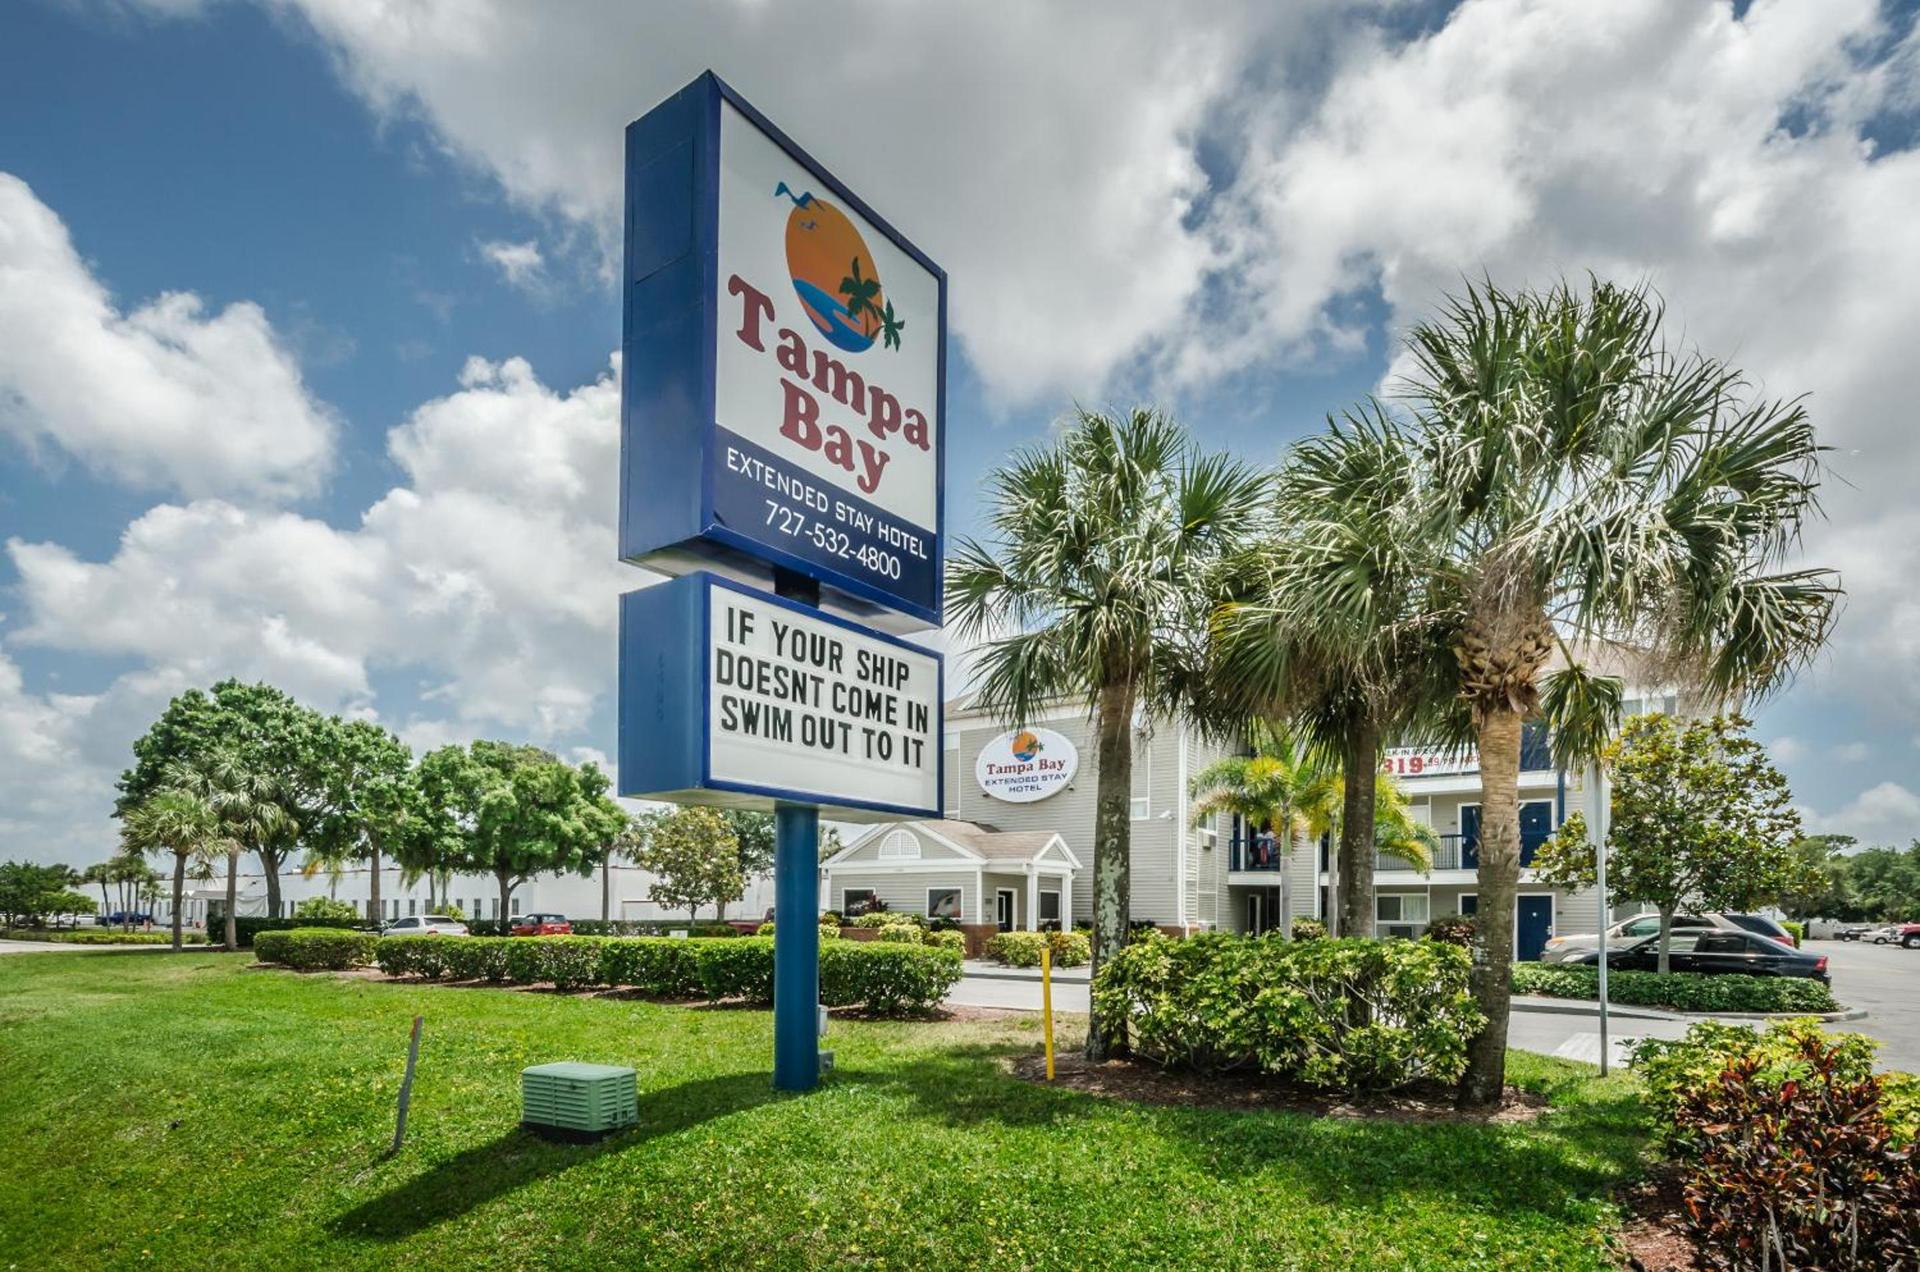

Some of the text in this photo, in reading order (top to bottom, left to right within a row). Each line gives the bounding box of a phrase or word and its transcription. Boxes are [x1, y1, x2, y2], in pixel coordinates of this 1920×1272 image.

[728, 274, 930, 452] Tampa
[780, 377, 890, 494] Bay
[727, 447, 928, 560] EXTENDED STAY HOTEL
[765, 499, 901, 580] 727-532-4800
[727, 606, 909, 691] IF YOUR SHIP
[716, 648, 824, 709] DOESNT
[832, 681, 897, 726] COME
[907, 700, 928, 734] IN
[721, 694, 924, 768] SWIM OUT TO IT
[985, 773, 1068, 786] EXTENDED STAY
[986, 759, 1065, 775] Tampa Bay
[1008, 784, 1042, 793] HOTEL
